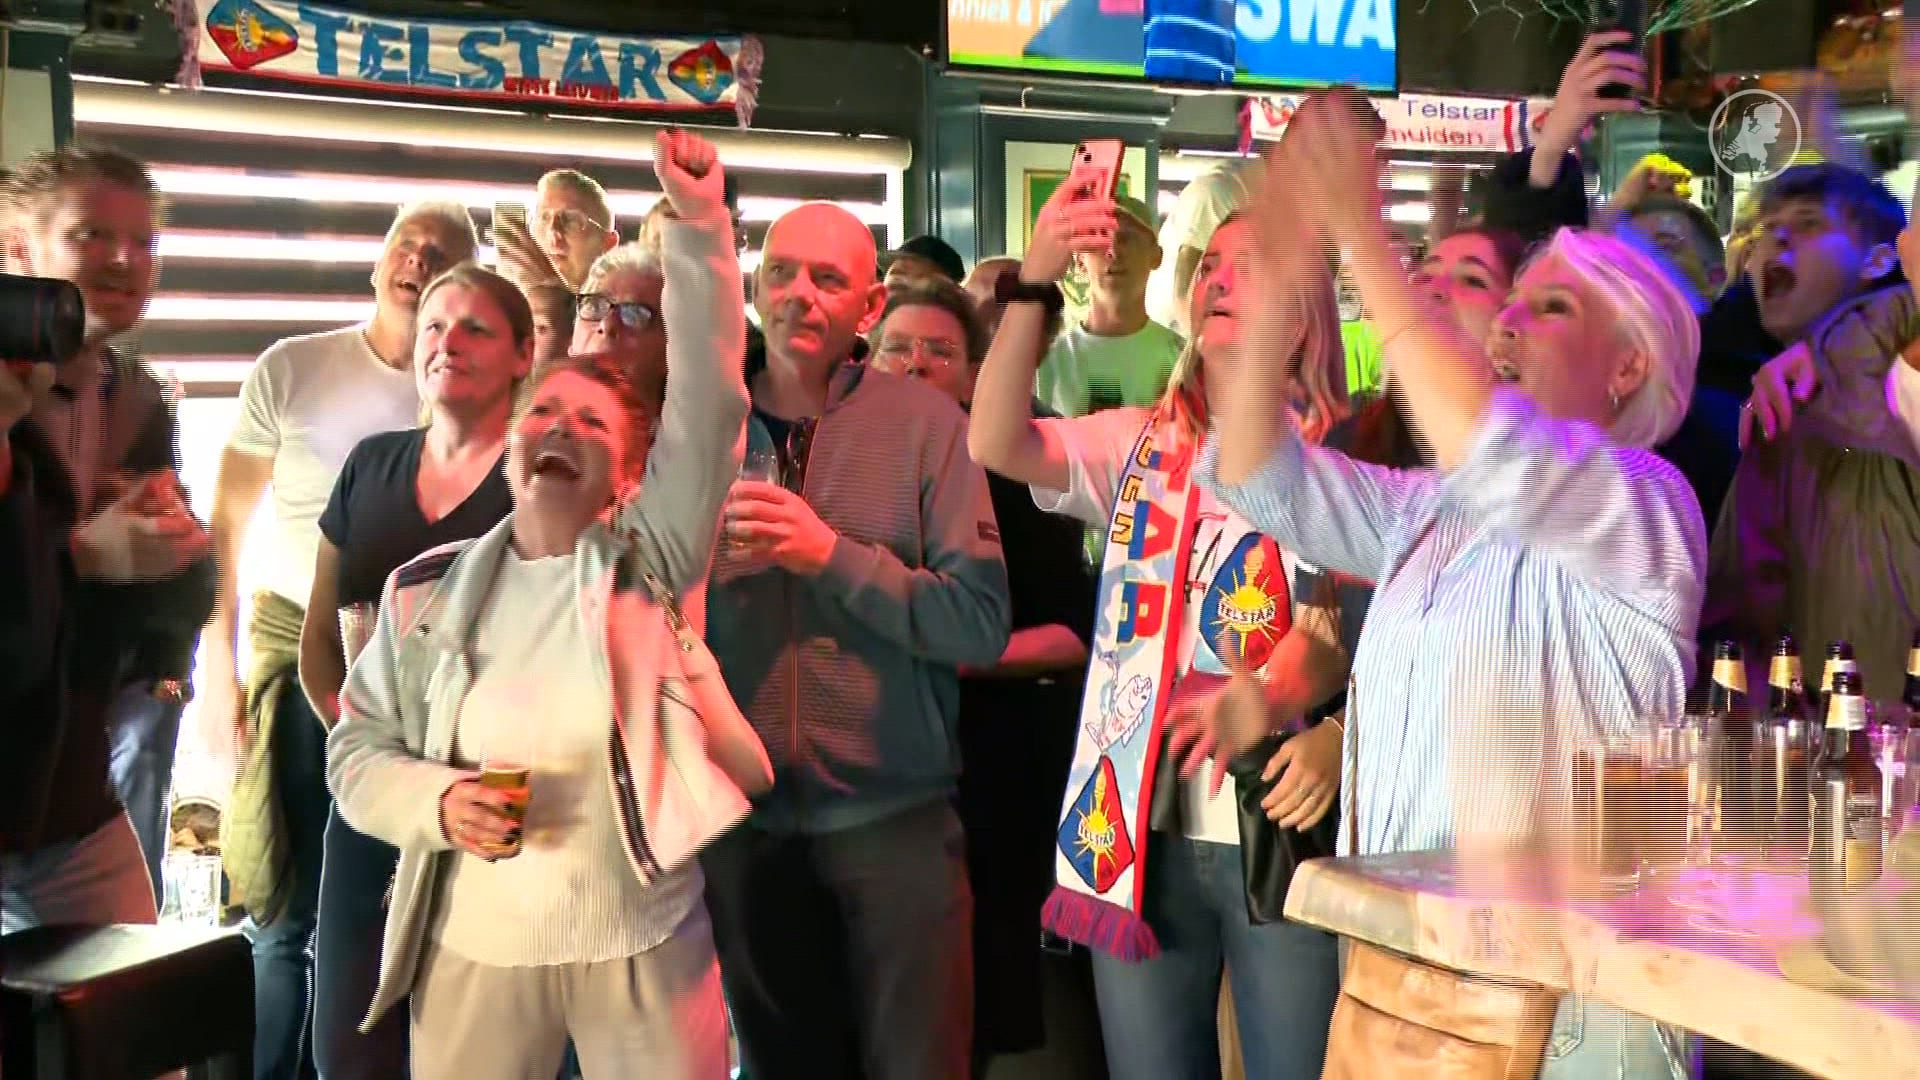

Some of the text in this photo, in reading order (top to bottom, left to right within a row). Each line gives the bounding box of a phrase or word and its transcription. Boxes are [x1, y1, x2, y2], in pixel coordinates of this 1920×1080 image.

[297, 9, 667, 102] TELSTAR
[1407, 99, 1501, 121] Telstar
[1220, 602, 1275, 623] TELSTAR
